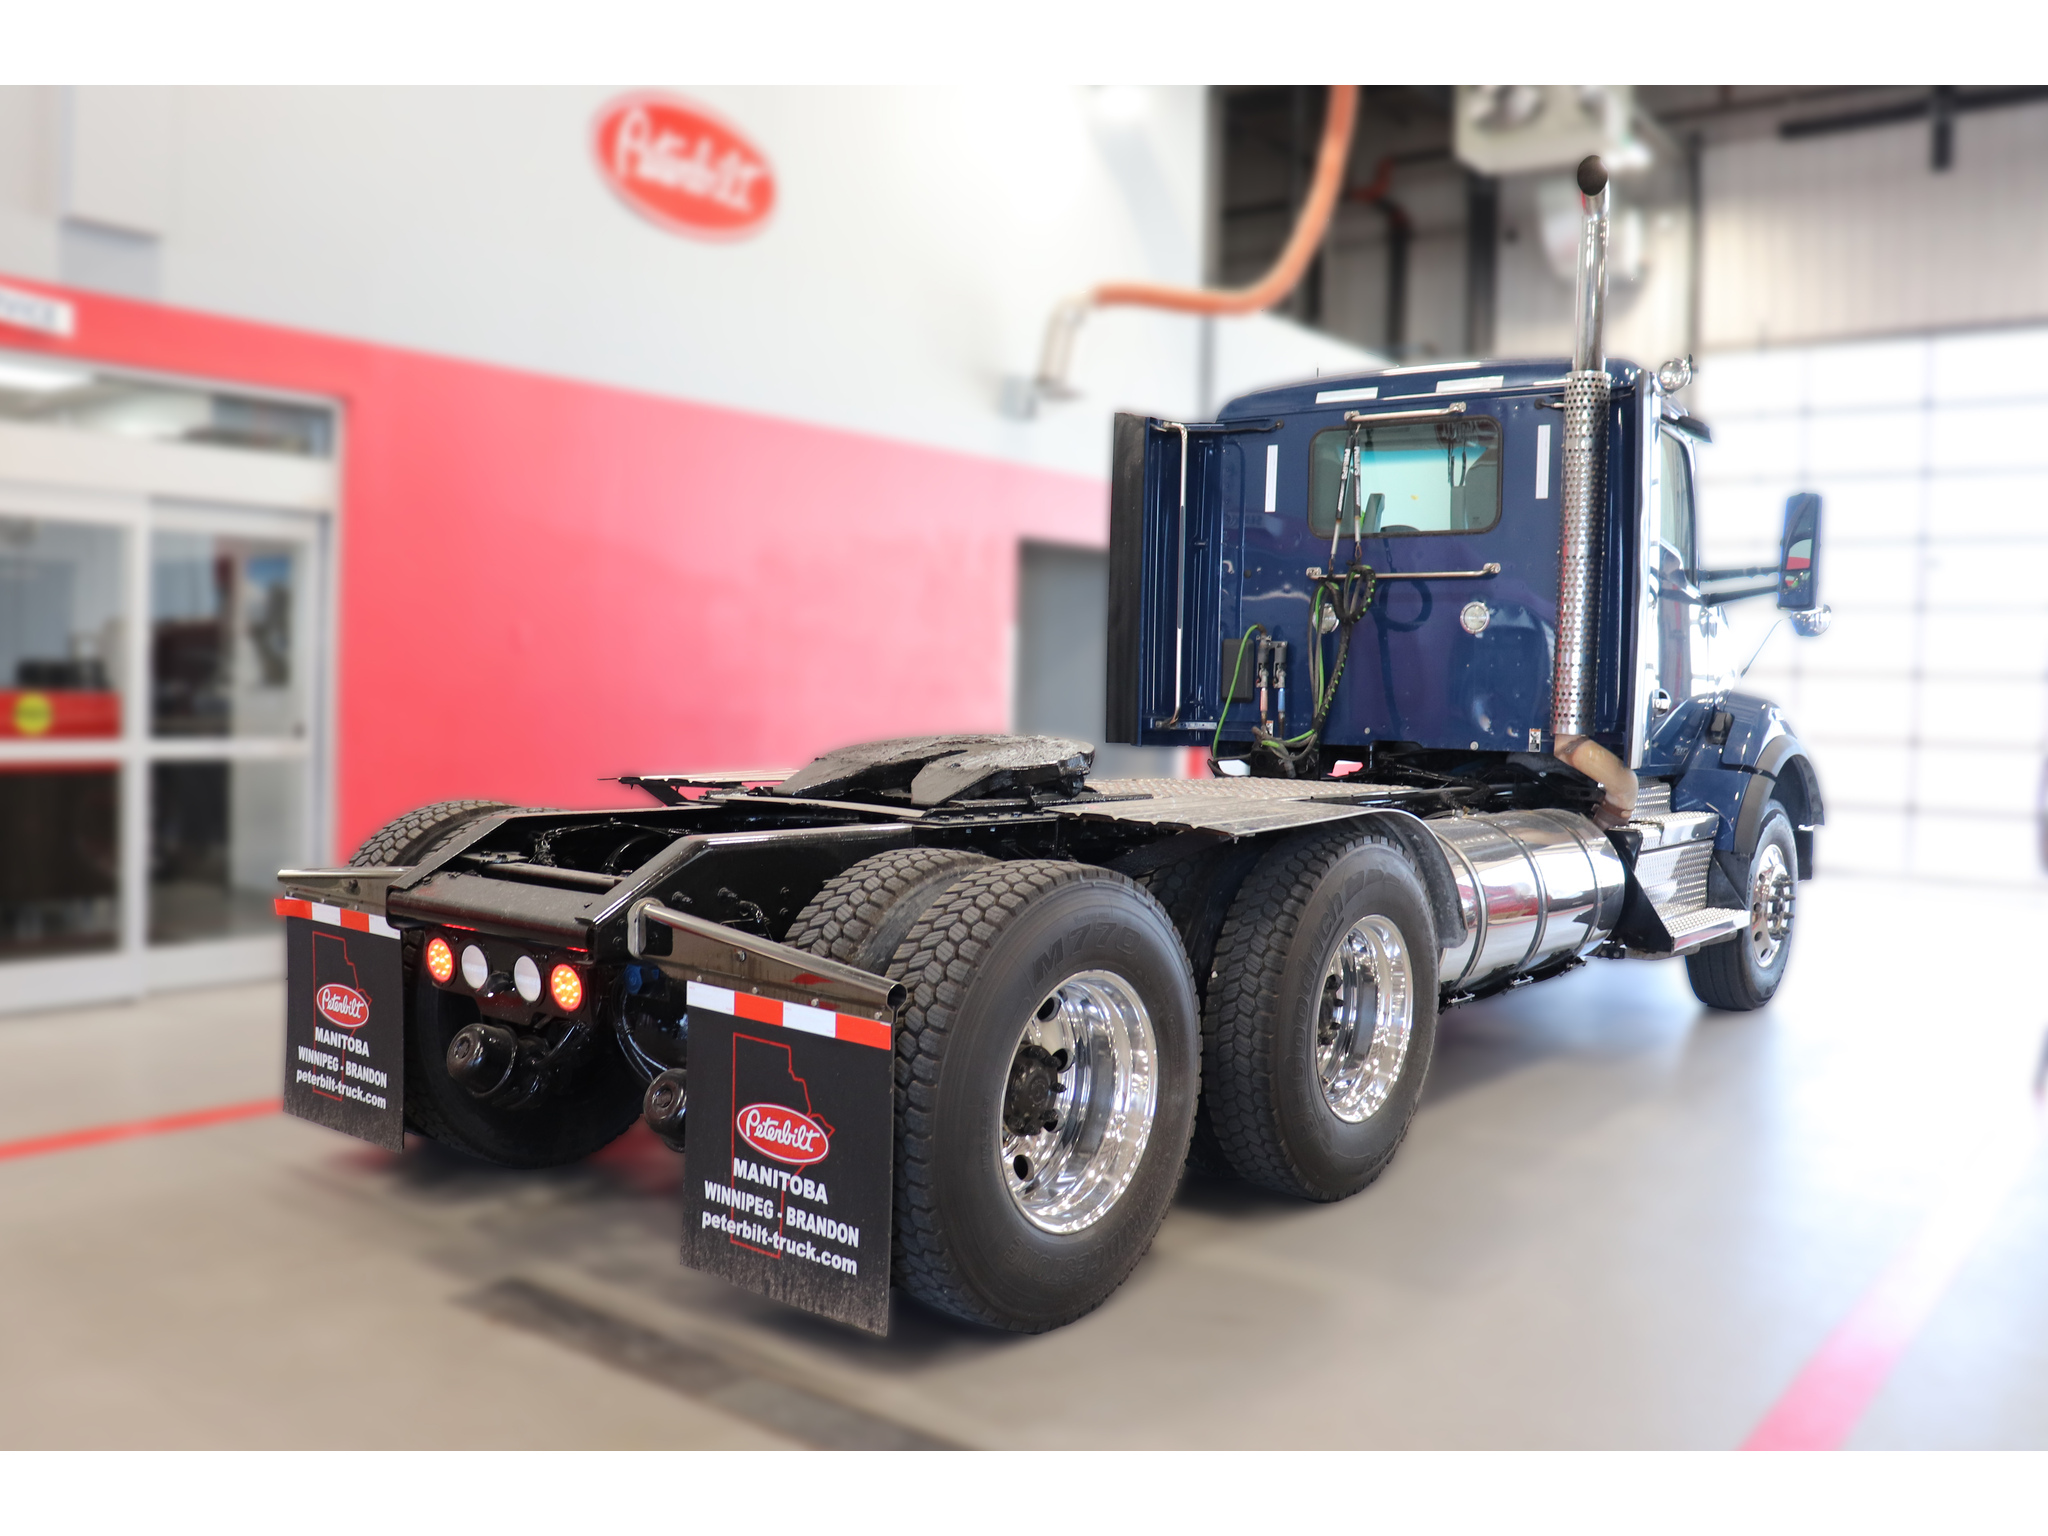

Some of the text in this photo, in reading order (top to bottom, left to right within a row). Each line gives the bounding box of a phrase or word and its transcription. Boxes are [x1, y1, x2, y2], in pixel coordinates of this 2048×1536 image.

[1031, 921, 1142, 989] M770
[321, 988, 365, 1018] Peterbilt
[314, 1026, 370, 1058] MANITOBA
[298, 1045, 339, 1073] WINNIPEG
[345, 1060, 388, 1089] BRANDON
[296, 1069, 387, 1110] peterbilt-truck.com
[745, 1108, 821, 1152] Peterbilt
[733, 1157, 829, 1204] MANITOBA
[704, 1179, 775, 1220] WINNIPEG
[786, 1205, 860, 1248] BRANDON
[702, 1210, 858, 1276] peterbilt-truck.com
